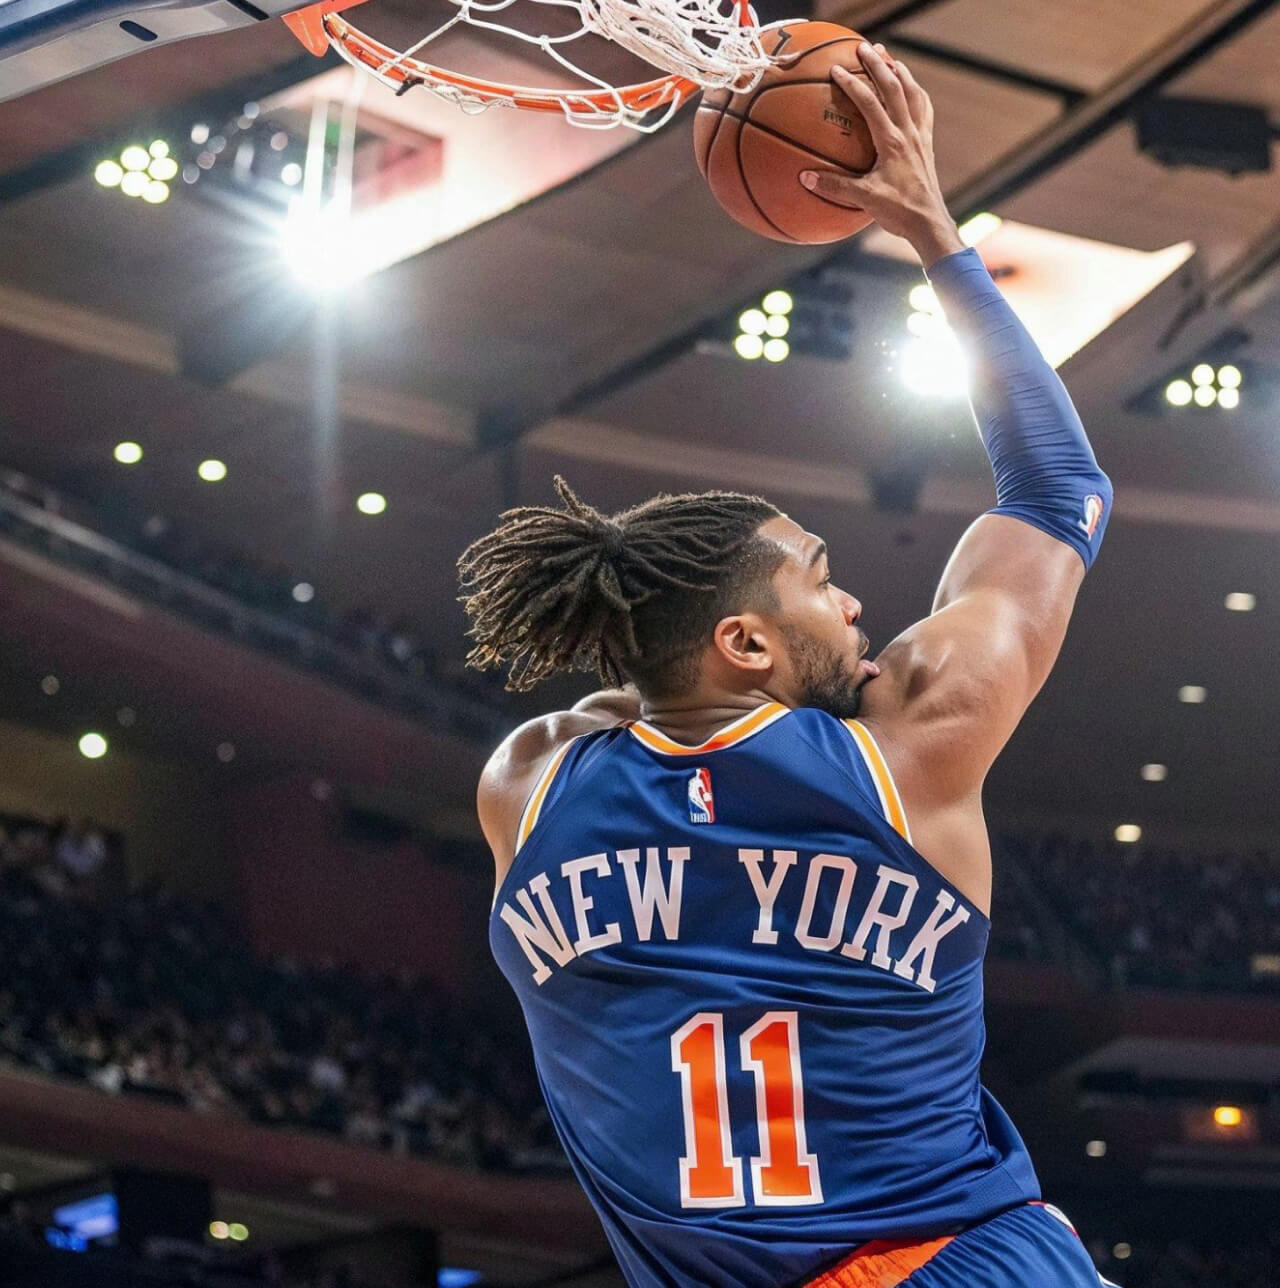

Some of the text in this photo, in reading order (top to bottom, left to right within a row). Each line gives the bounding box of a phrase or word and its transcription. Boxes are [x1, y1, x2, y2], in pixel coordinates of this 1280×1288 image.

[500, 847, 970, 993] NEW YORK
[670, 1011, 824, 1209] 11
